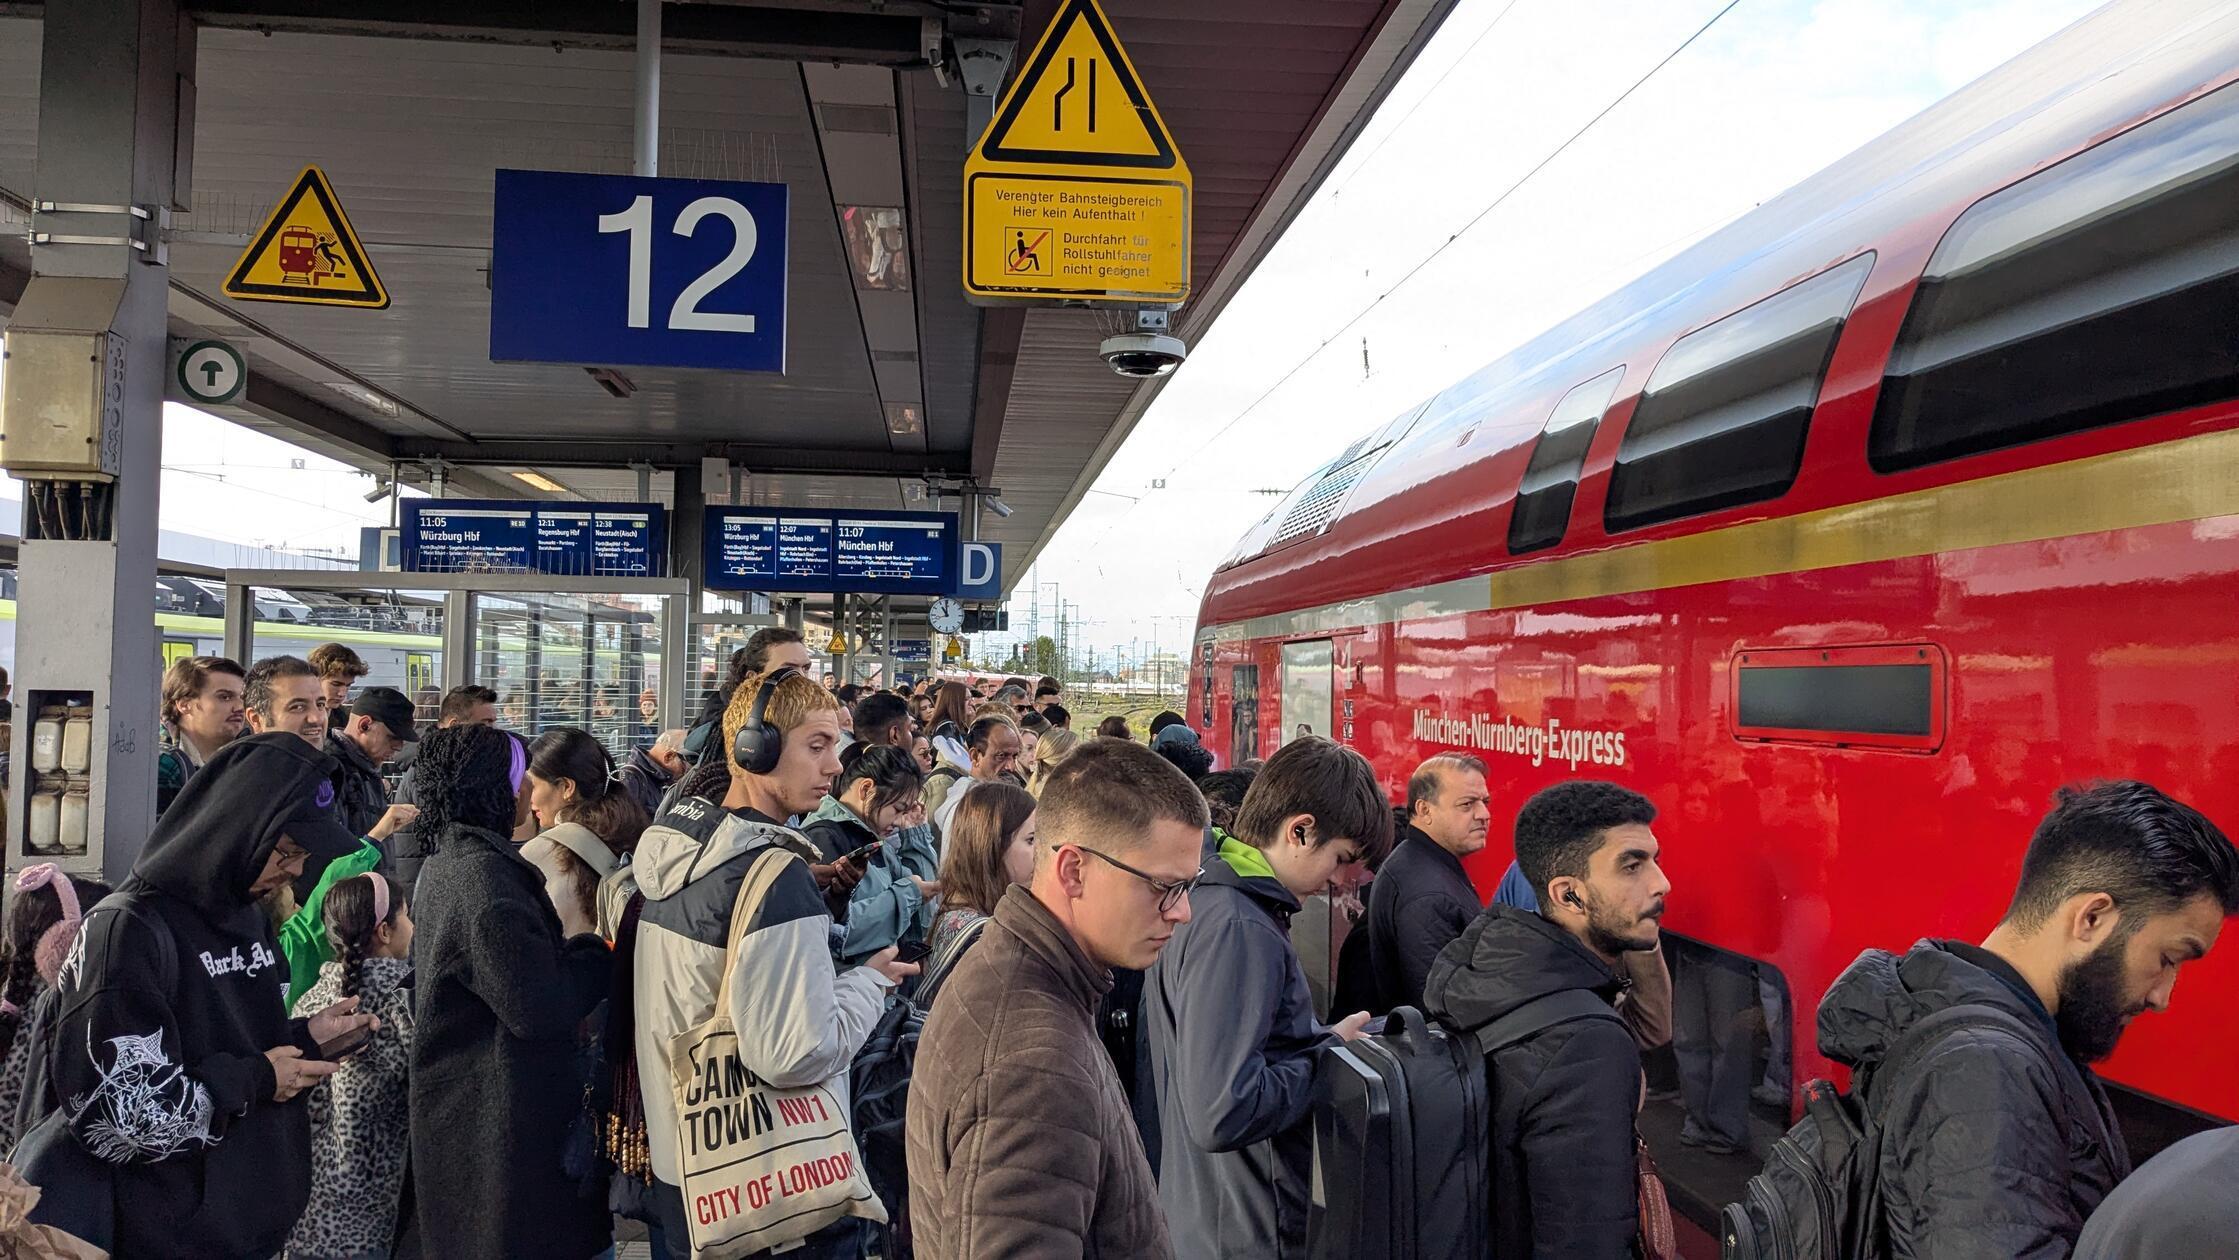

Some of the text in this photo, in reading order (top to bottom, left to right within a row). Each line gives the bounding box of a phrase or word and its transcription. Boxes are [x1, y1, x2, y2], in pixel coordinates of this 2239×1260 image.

[996, 189, 1163, 208] Verengter Bahnsteigbereich
[1013, 205, 1037, 217] Hier
[1043, 207, 1067, 218] kein
[1073, 208, 1136, 221] Aufenthalt
[1063, 232, 1127, 246] Durchfahrt
[1063, 248, 1152, 262] Rollstuhlfahrer
[599, 195, 757, 333] 12
[1063, 263, 1150, 279] nicht geeignet
[420, 517, 447, 527] 11:05
[420, 530, 480, 543] Würzburg Hbf
[538, 529, 569, 537] Regensburg
[724, 533, 749, 541] Würzburg
[838, 527, 864, 537] 11:07
[838, 540, 894, 551] München Hbf
[962, 543, 995, 585] D
[1413, 708, 1625, 771] München-Nürnberg-Express
[667, 801, 705, 821] mbia
[199, 946, 247, 978] Dark
[685, 1092, 829, 1156] TOWN NW1
[696, 1151, 855, 1225] CITY OF LONDON
